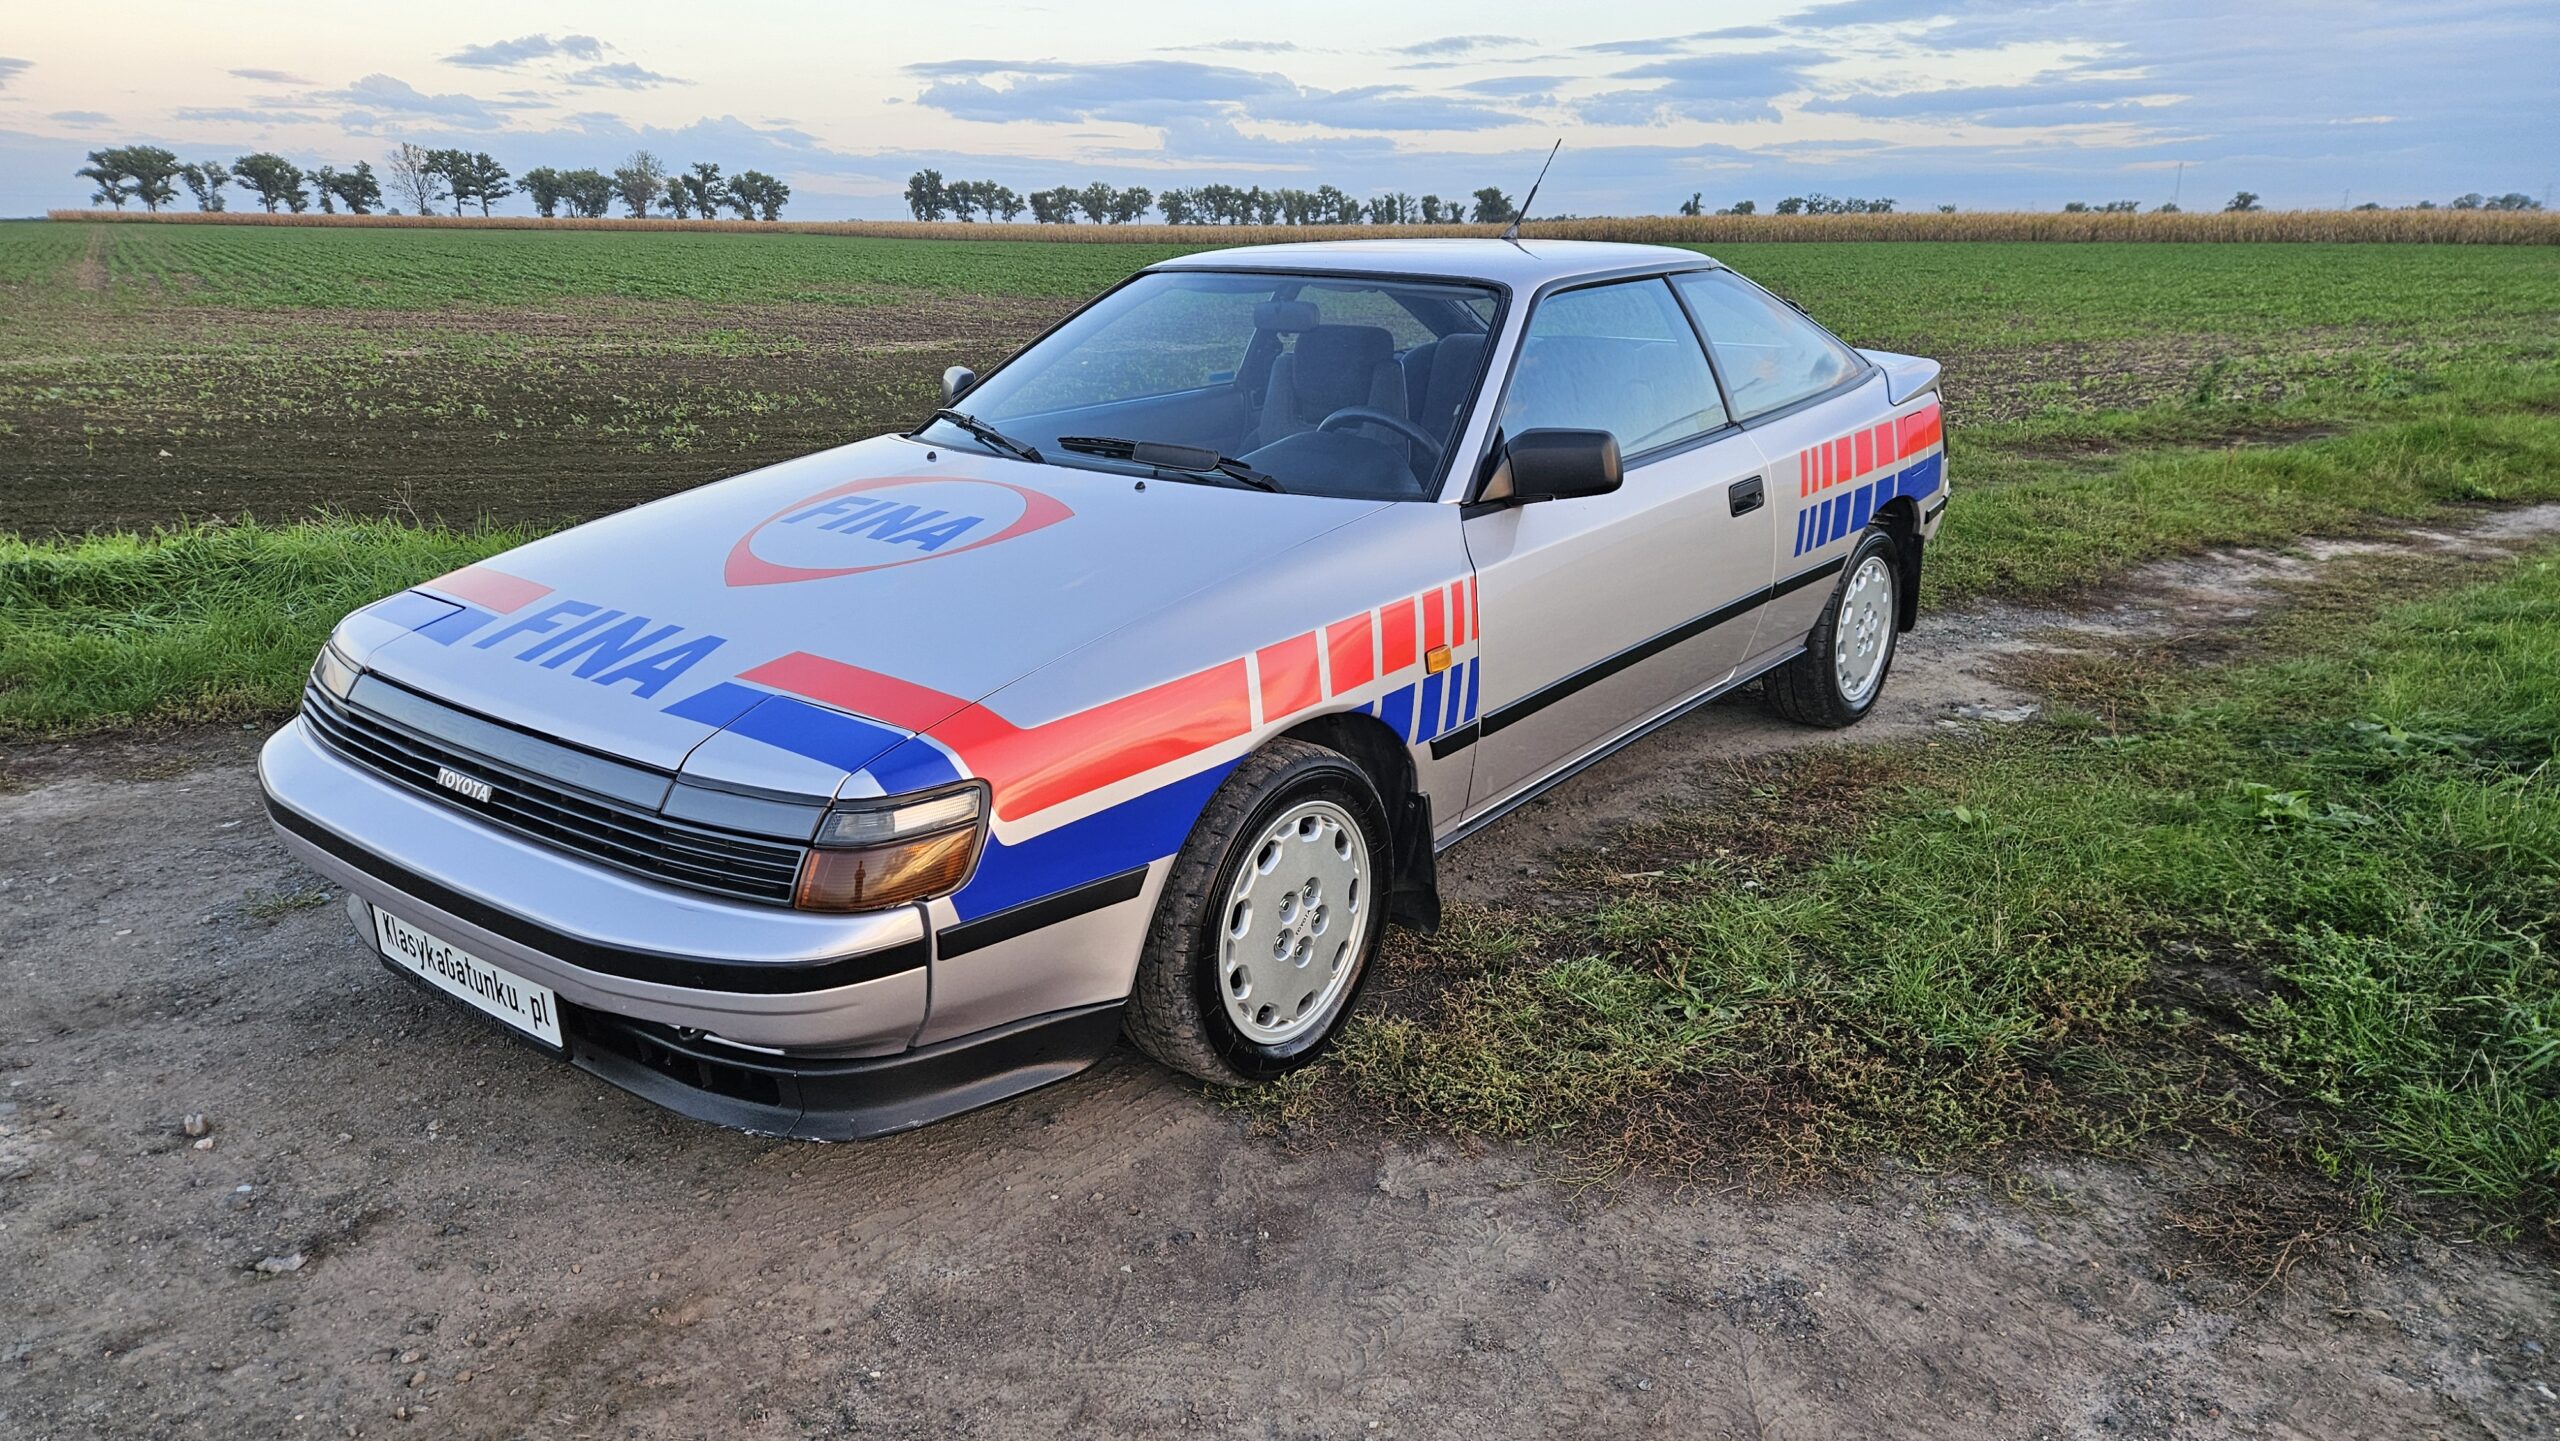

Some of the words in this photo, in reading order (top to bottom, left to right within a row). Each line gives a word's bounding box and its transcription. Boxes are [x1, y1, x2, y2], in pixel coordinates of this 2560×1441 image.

[779, 496, 985, 552] FINA
[471, 600, 728, 699] FINA
[438, 767, 490, 803] TOYOTA
[382, 912, 551, 1029] KlasykaGatunku.pl
